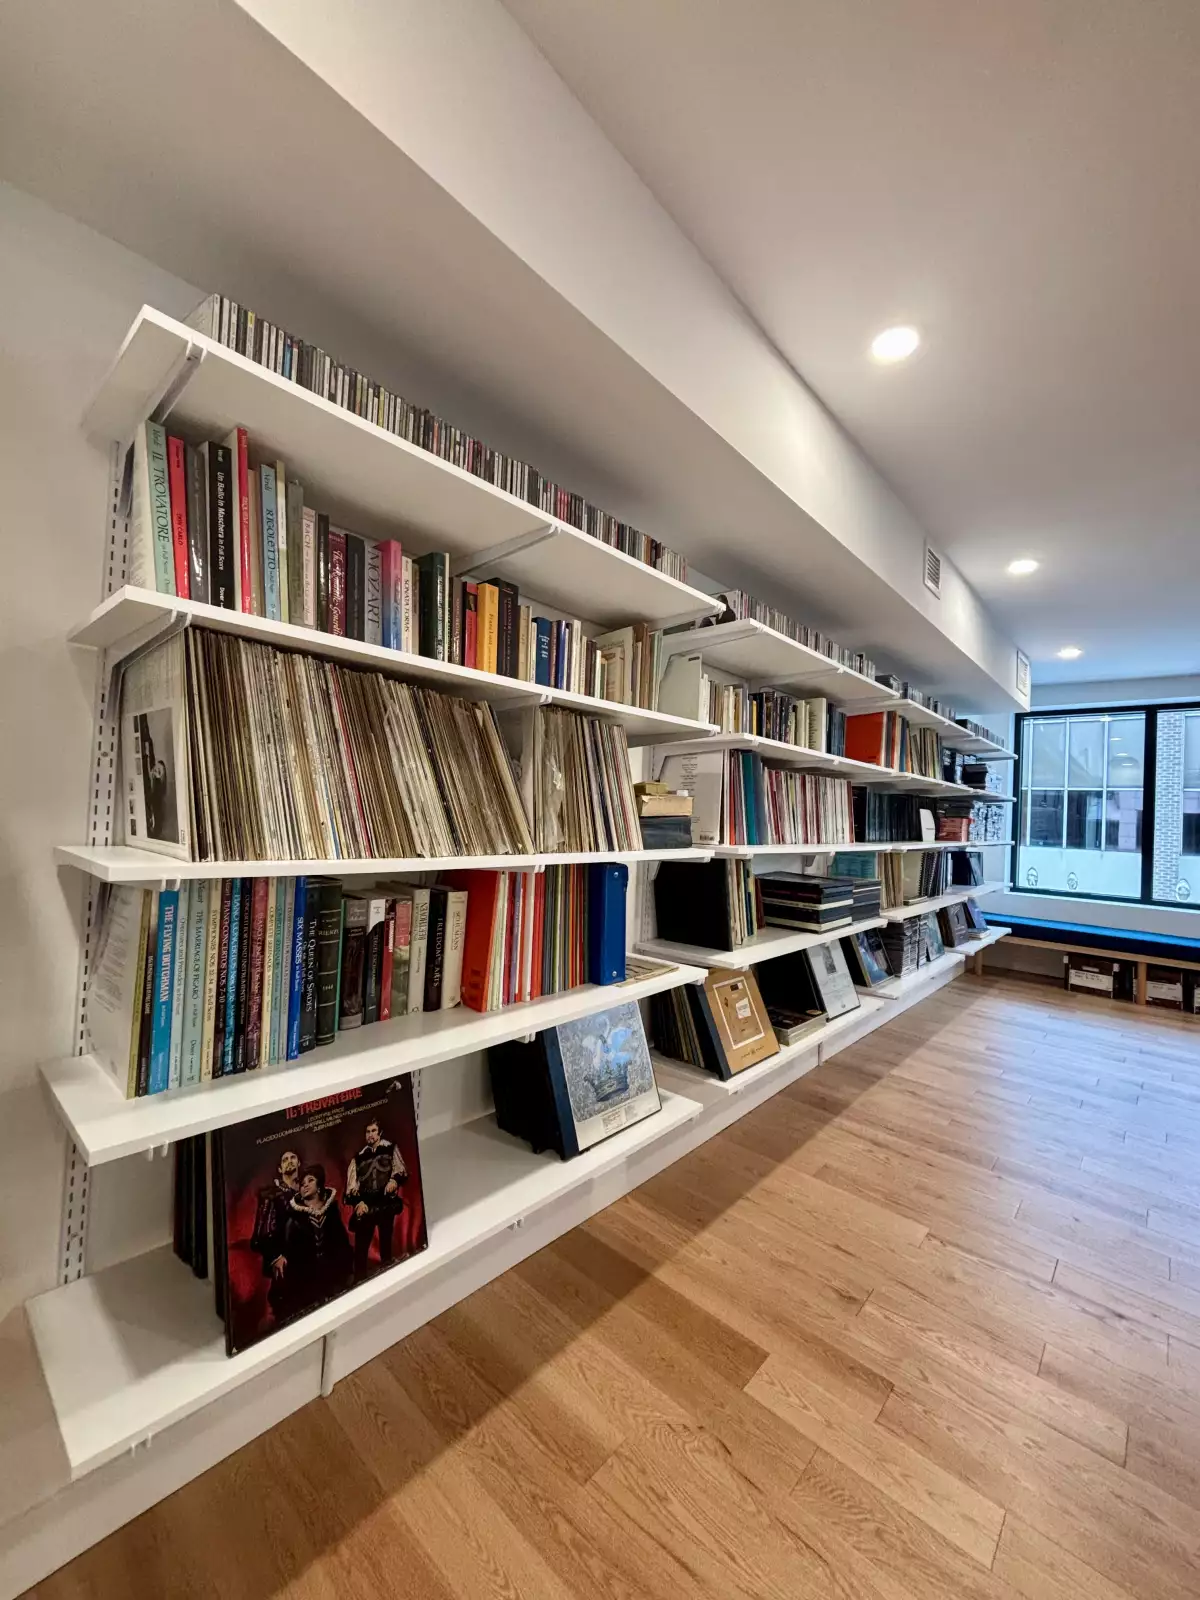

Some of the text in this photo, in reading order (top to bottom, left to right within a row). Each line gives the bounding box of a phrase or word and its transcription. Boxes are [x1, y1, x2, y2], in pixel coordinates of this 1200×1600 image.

[151, 428, 161, 448] Verdi
[152, 451, 165, 465] IL
[217, 471, 225, 481] Un
[263, 473, 271, 492] Verdi
[217, 482, 225, 499] Ballo
[217, 499, 225, 507] in
[152, 467, 170, 544] TROVATORE
[217, 507, 226, 539] Maschera
[218, 545, 226, 556] Full
[265, 509, 277, 571] RIGOLETTO
[218, 556, 226, 572] Score
[329, 551, 343, 636] The Romantic Generati
[367, 551, 380, 629] MOZART
[164, 905, 174, 923] THE
[196, 910, 204, 924] THE
[223, 900, 232, 925] PIANO
[232, 894, 241, 921] PIANO
[242, 894, 250, 926] CONCERTI
[417, 902, 428, 941] BEETHOVEN
[210, 910, 218, 951] SYMPHONIES
[297, 916, 305, 930] SIX
[453, 911, 462, 951] SCHUMANN
[162, 924, 173, 953] FLYING
[194, 926, 203, 963] MARRIAGE
[220, 925, 230, 969] CONCERTOS
[230, 921, 239, 968] CONCERTOS
[241, 939, 249, 958] WIND
[295, 932, 304, 965] MASSES
[436, 918, 444, 958] FREEDOM
[160, 954, 171, 1003] DUTCHMAN
[193, 964, 201, 973] OF
[219, 970, 227, 987] NOS.
[305, 919, 317, 1012] THE QUEEN OF SPADES
[433, 966, 441, 987] ARTS
[192, 974, 201, 1000] FIGARO
[239, 959, 248, 1002] INSTRUMENTS
